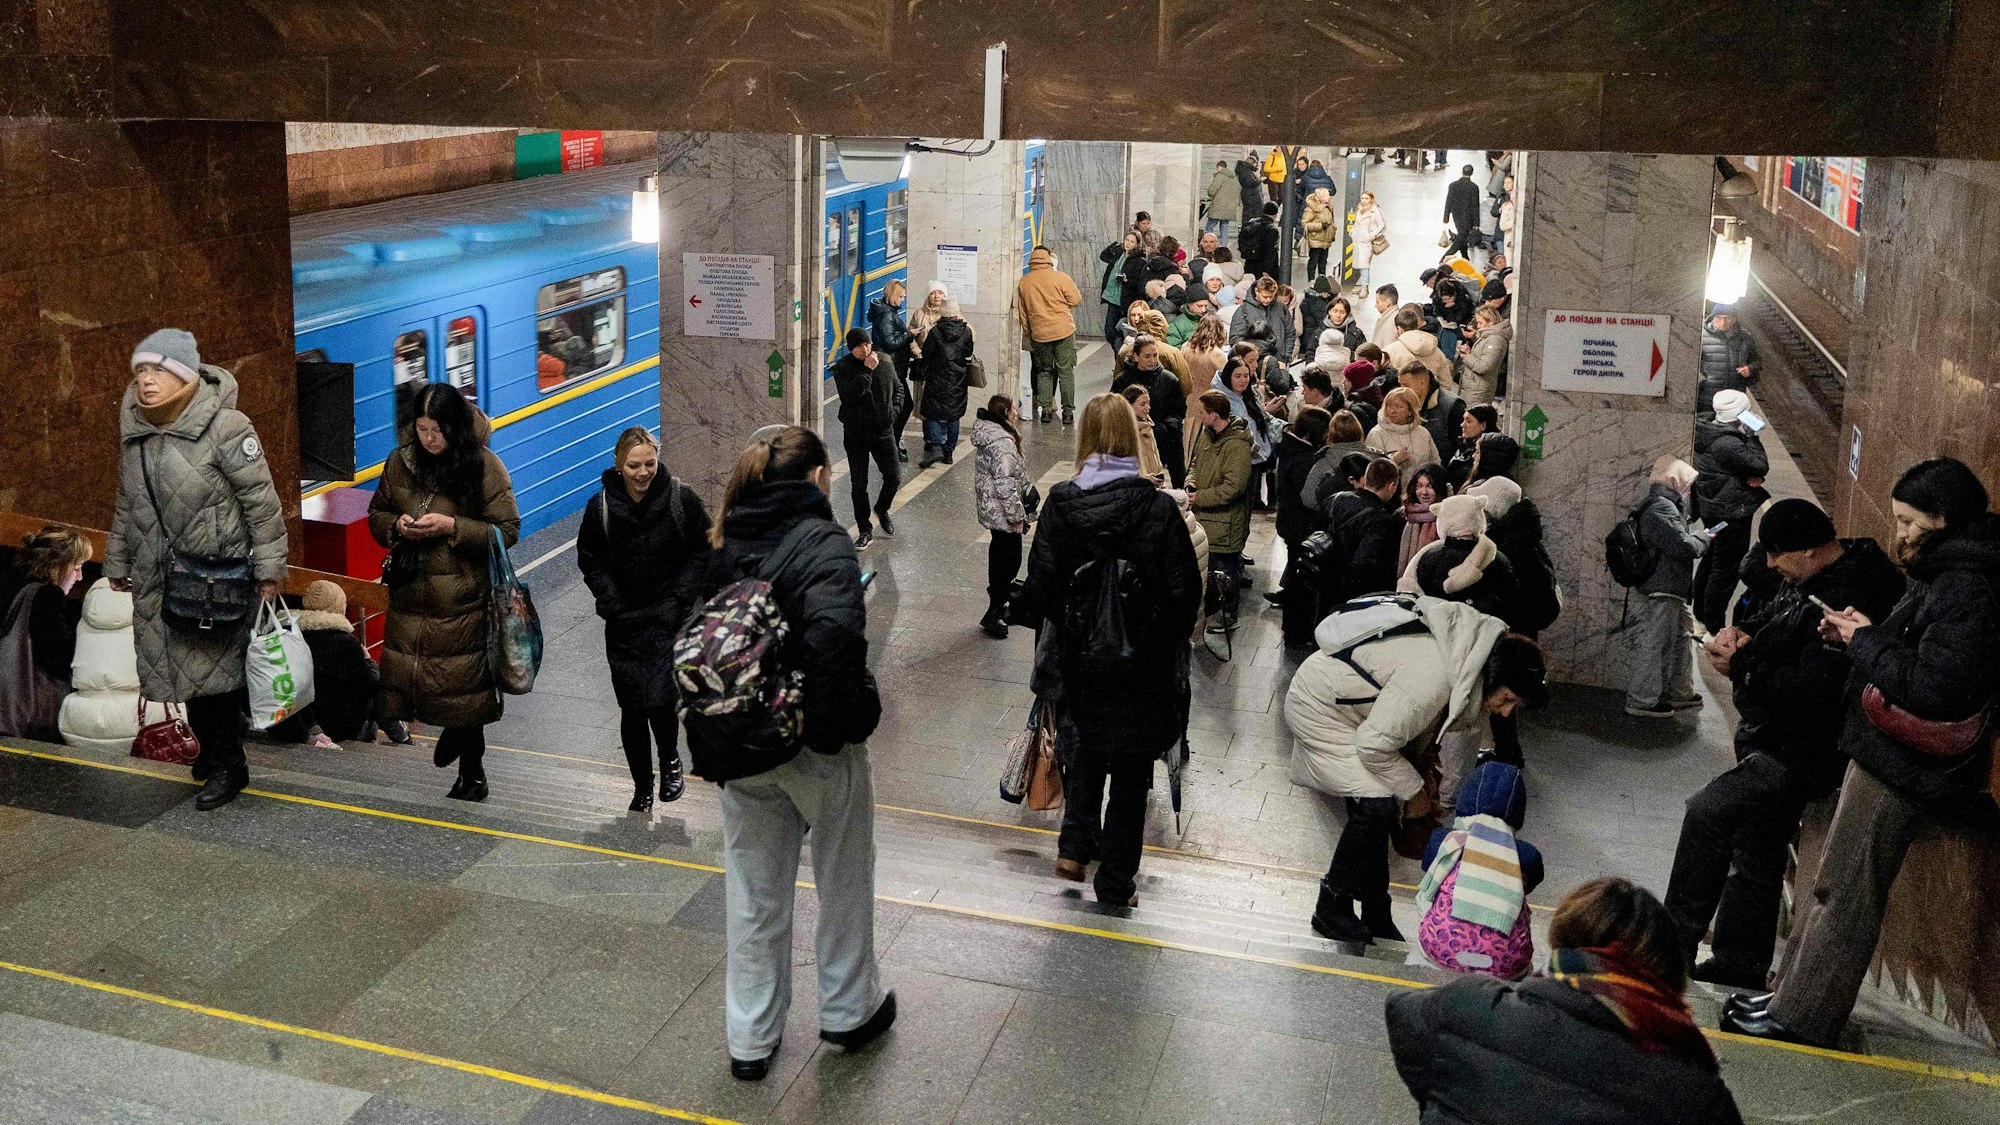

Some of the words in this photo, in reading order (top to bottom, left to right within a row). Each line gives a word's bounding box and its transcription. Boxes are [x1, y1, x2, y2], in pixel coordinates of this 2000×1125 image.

[1554, 315, 1566, 323] ДО
[1569, 315, 1602, 324] ПОЇЗДІВ
[1606, 317, 1617, 325] НА
[1620, 317, 1656, 327] СТАНЦІЇ:
[1583, 339, 1618, 348] ПОЧАЙНА,
